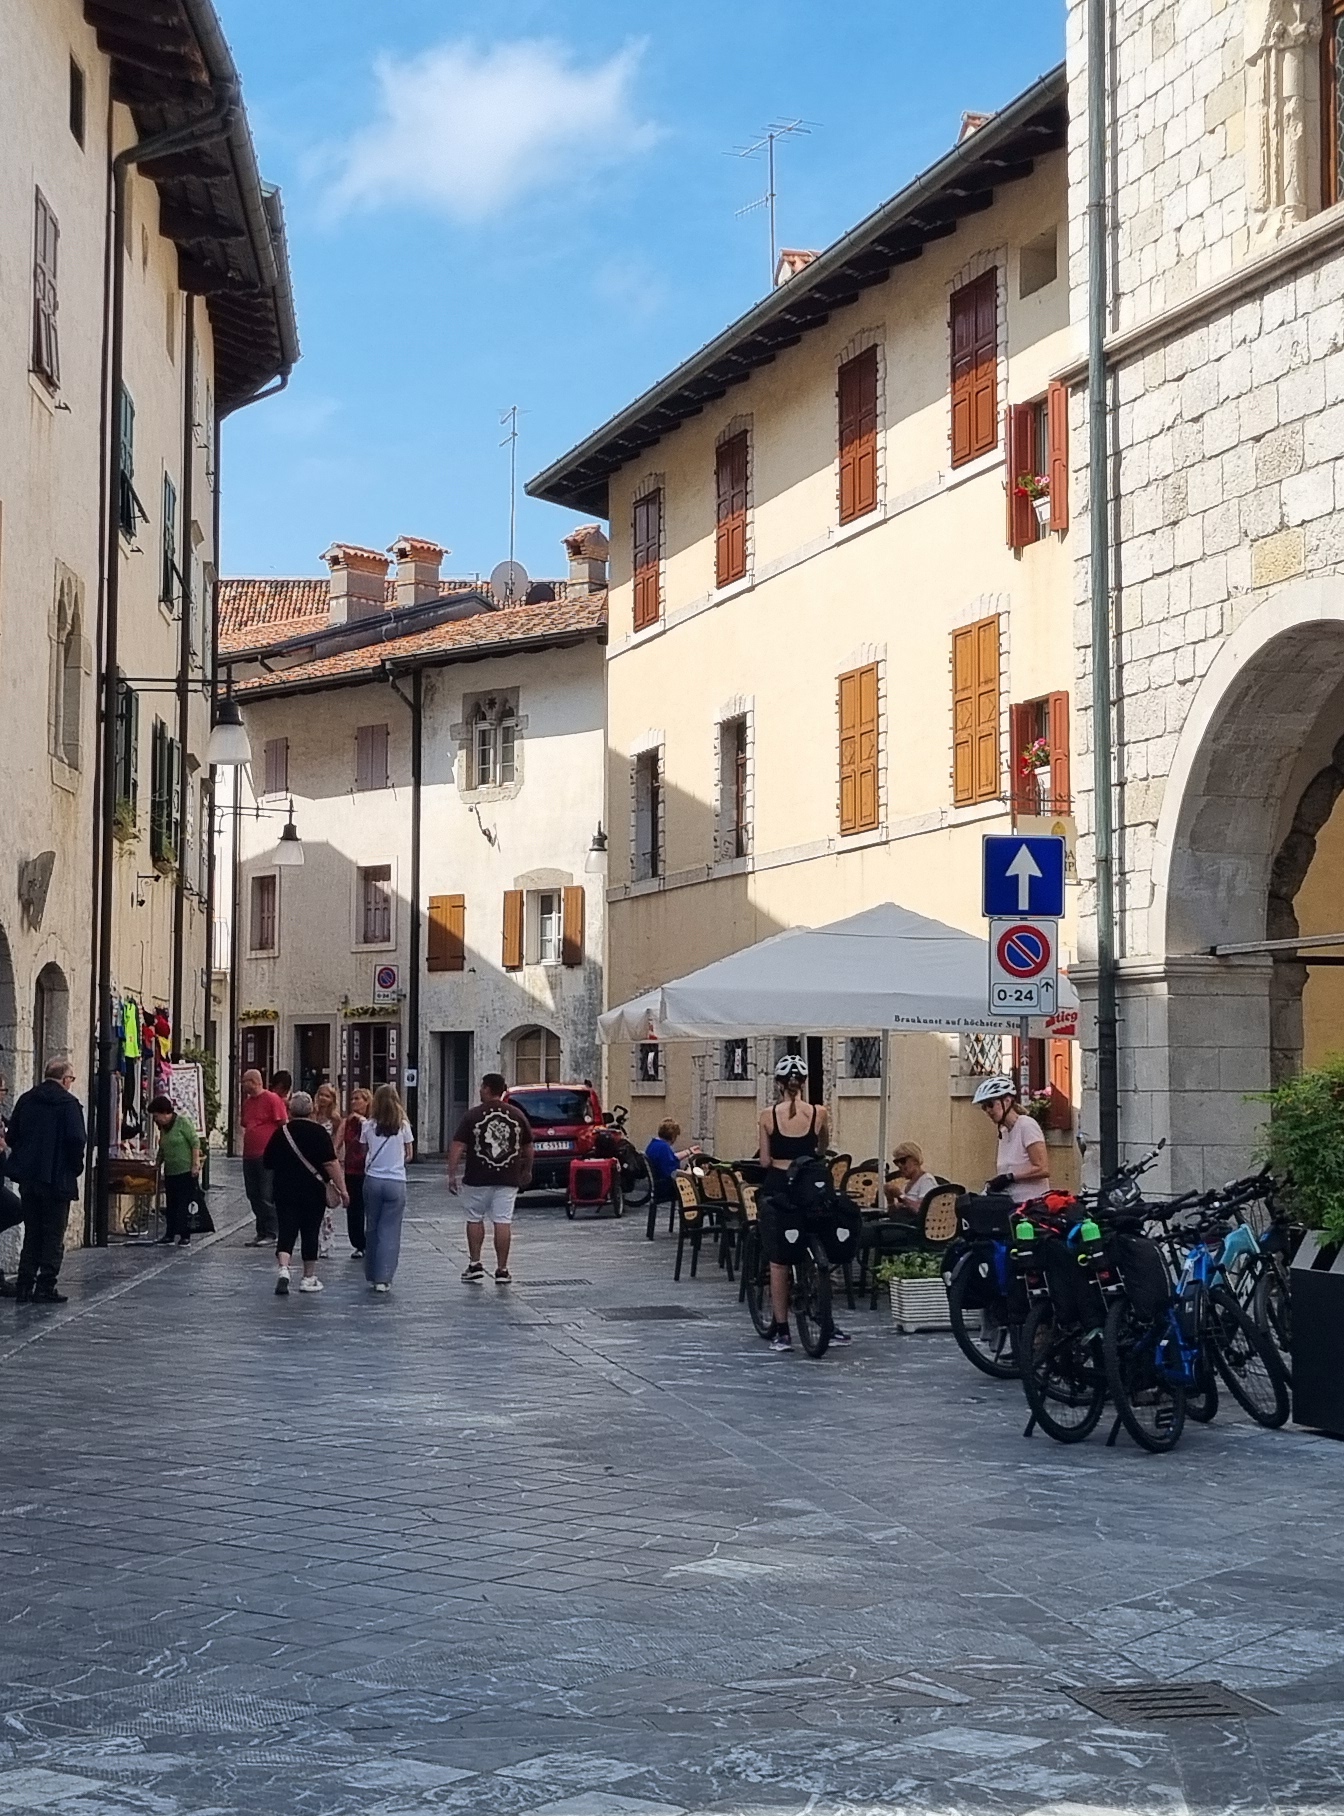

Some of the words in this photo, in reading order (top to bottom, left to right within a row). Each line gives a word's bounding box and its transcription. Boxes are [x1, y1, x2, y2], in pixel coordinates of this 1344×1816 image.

[997, 989, 1034, 1001] 0-24
[894, 1014, 942, 1025] Braukunst
[945, 1017, 962, 1026] auf
[963, 1018, 1003, 1028] höchster
[1005, 1020, 1033, 1030] Stu.
[1045, 1010, 1079, 1028] tieg
